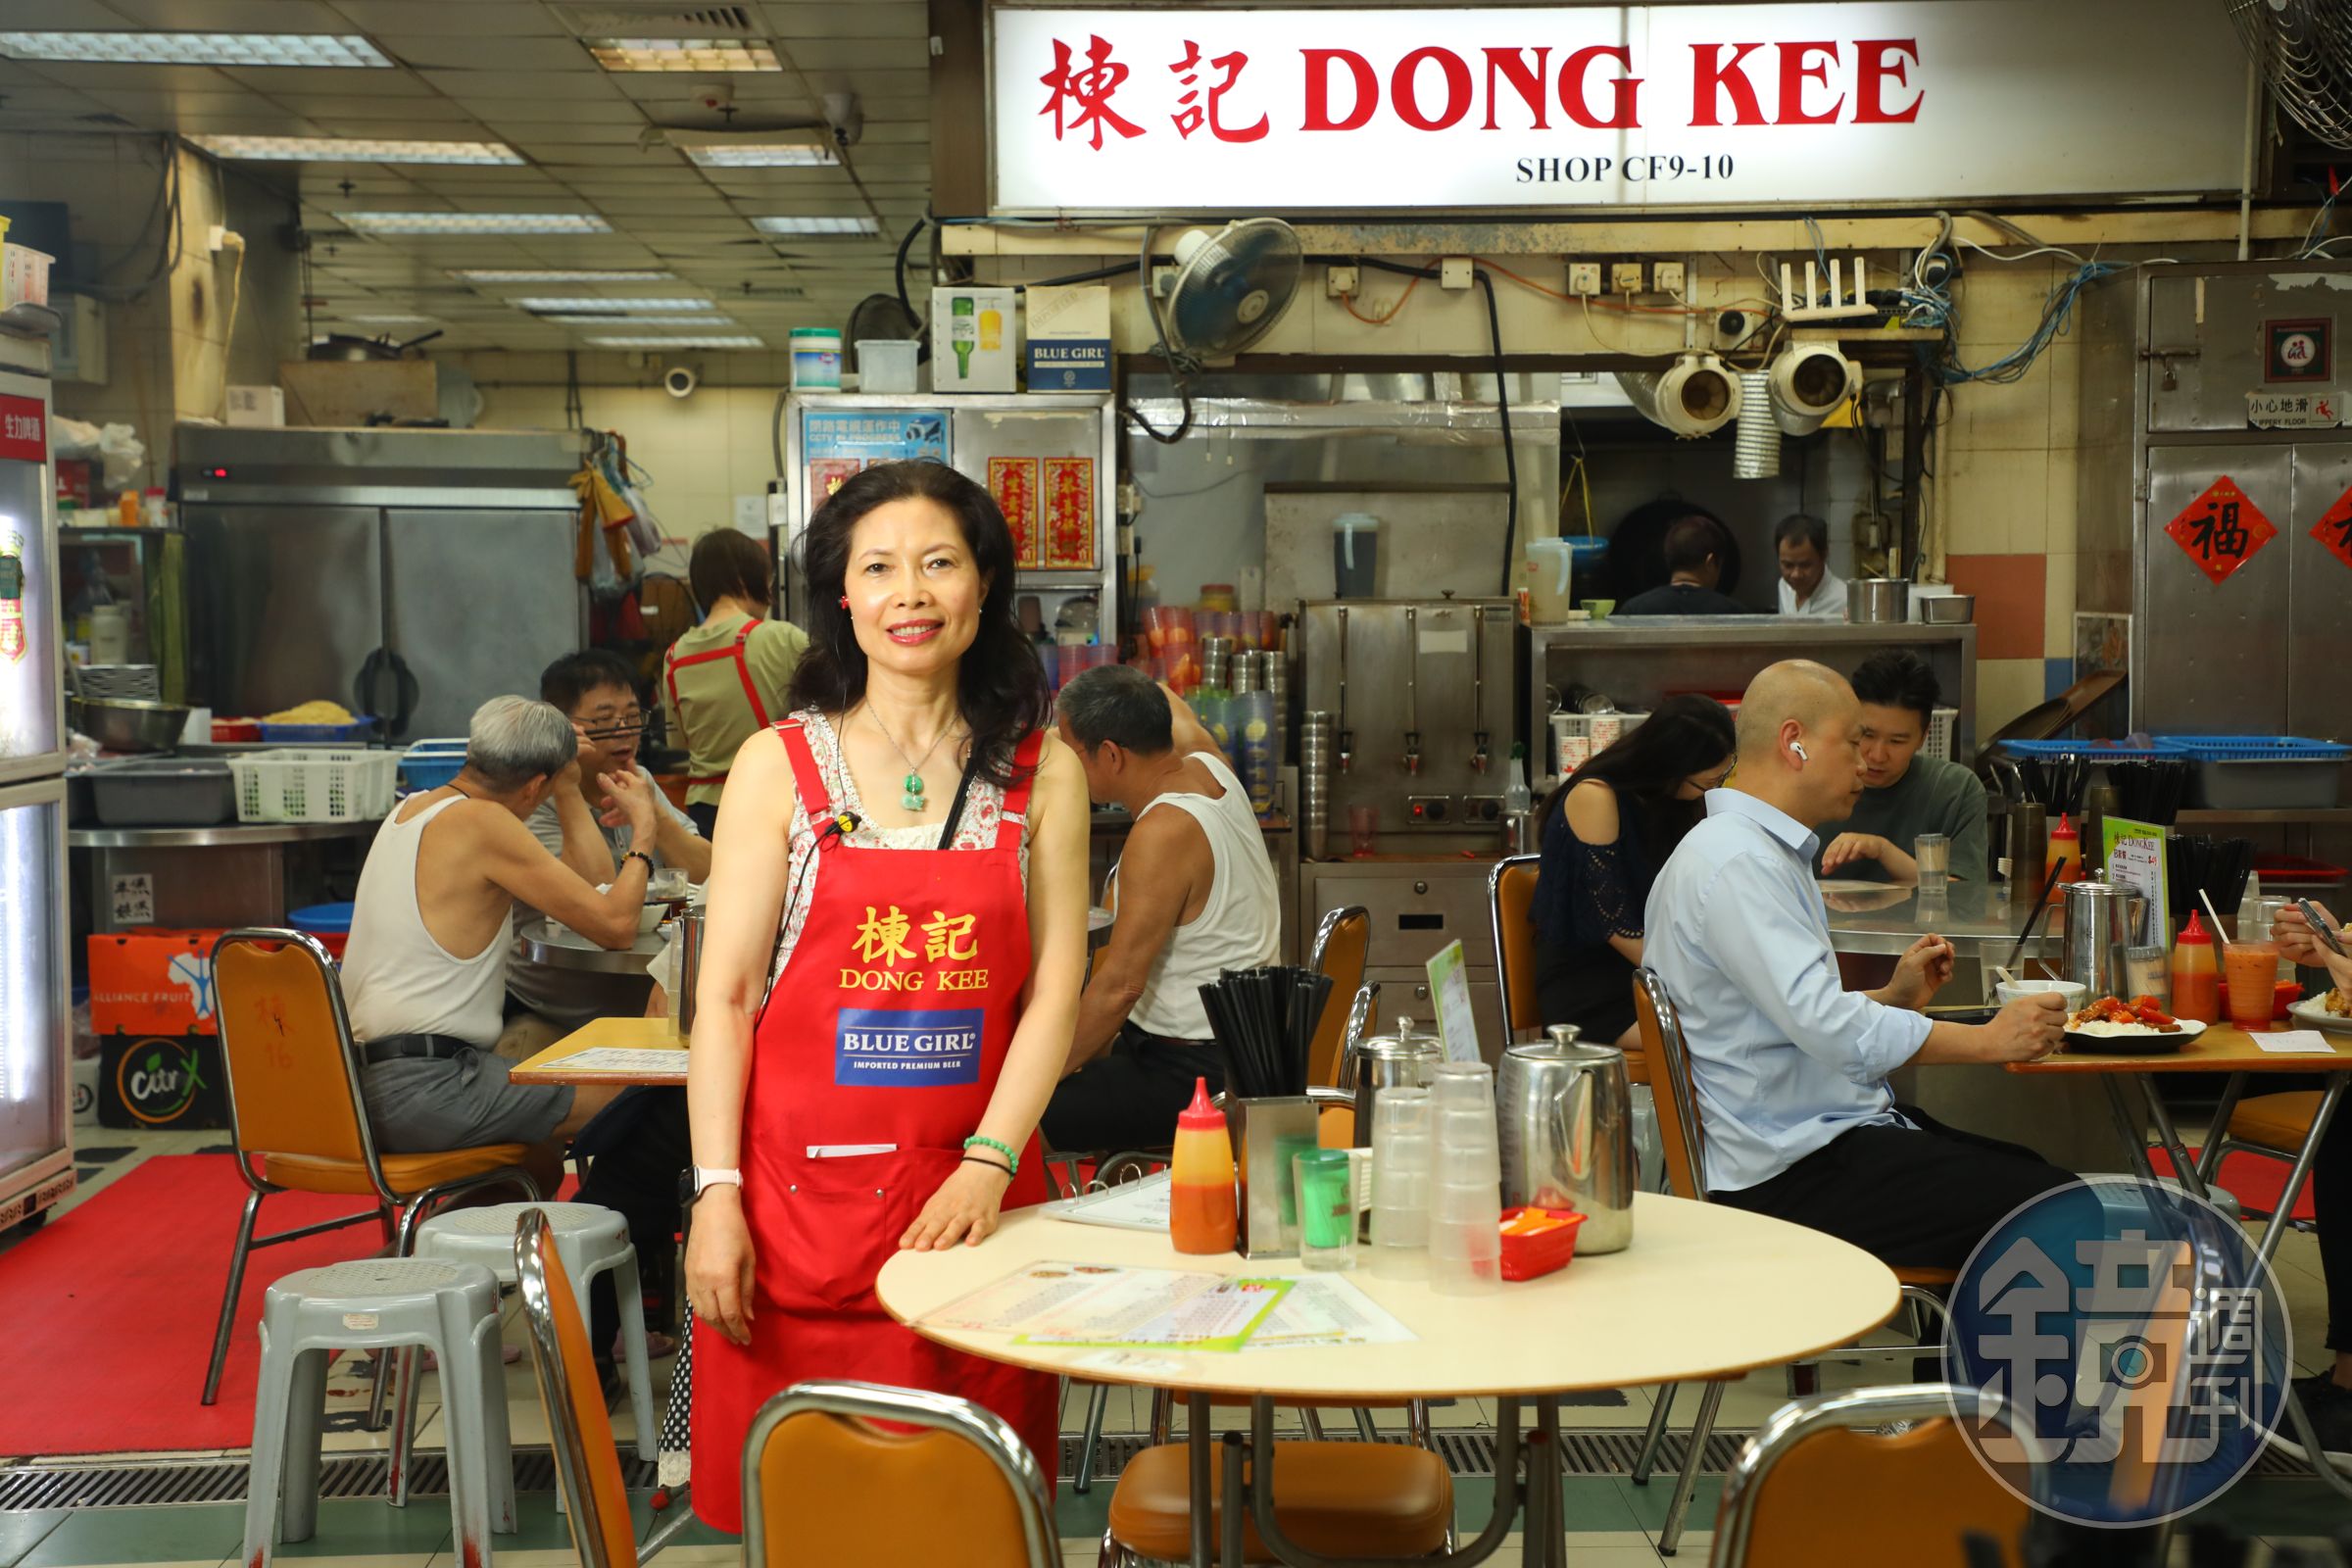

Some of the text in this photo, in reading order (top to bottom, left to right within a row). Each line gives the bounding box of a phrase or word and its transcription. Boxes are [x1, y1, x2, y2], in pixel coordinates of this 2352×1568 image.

[1039, 33, 1270, 151] 棟記
[1298, 37, 1926, 131] DONG KEE
[1515, 154, 1735, 183] SHOP CF9-10
[1034, 347, 1105, 360] BLUE GIRL
[2251, 398, 2308, 414] 小心地滑
[2189, 502, 2249, 560] 福
[852, 906, 978, 967] 棟記
[839, 968, 989, 991] DONG KEE
[93, 990, 191, 1004] ALLIANCE FRUIT
[843, 1033, 909, 1052] BLUE
[854, 1060, 961, 1070] IMPORTED PREMIUM BEER
